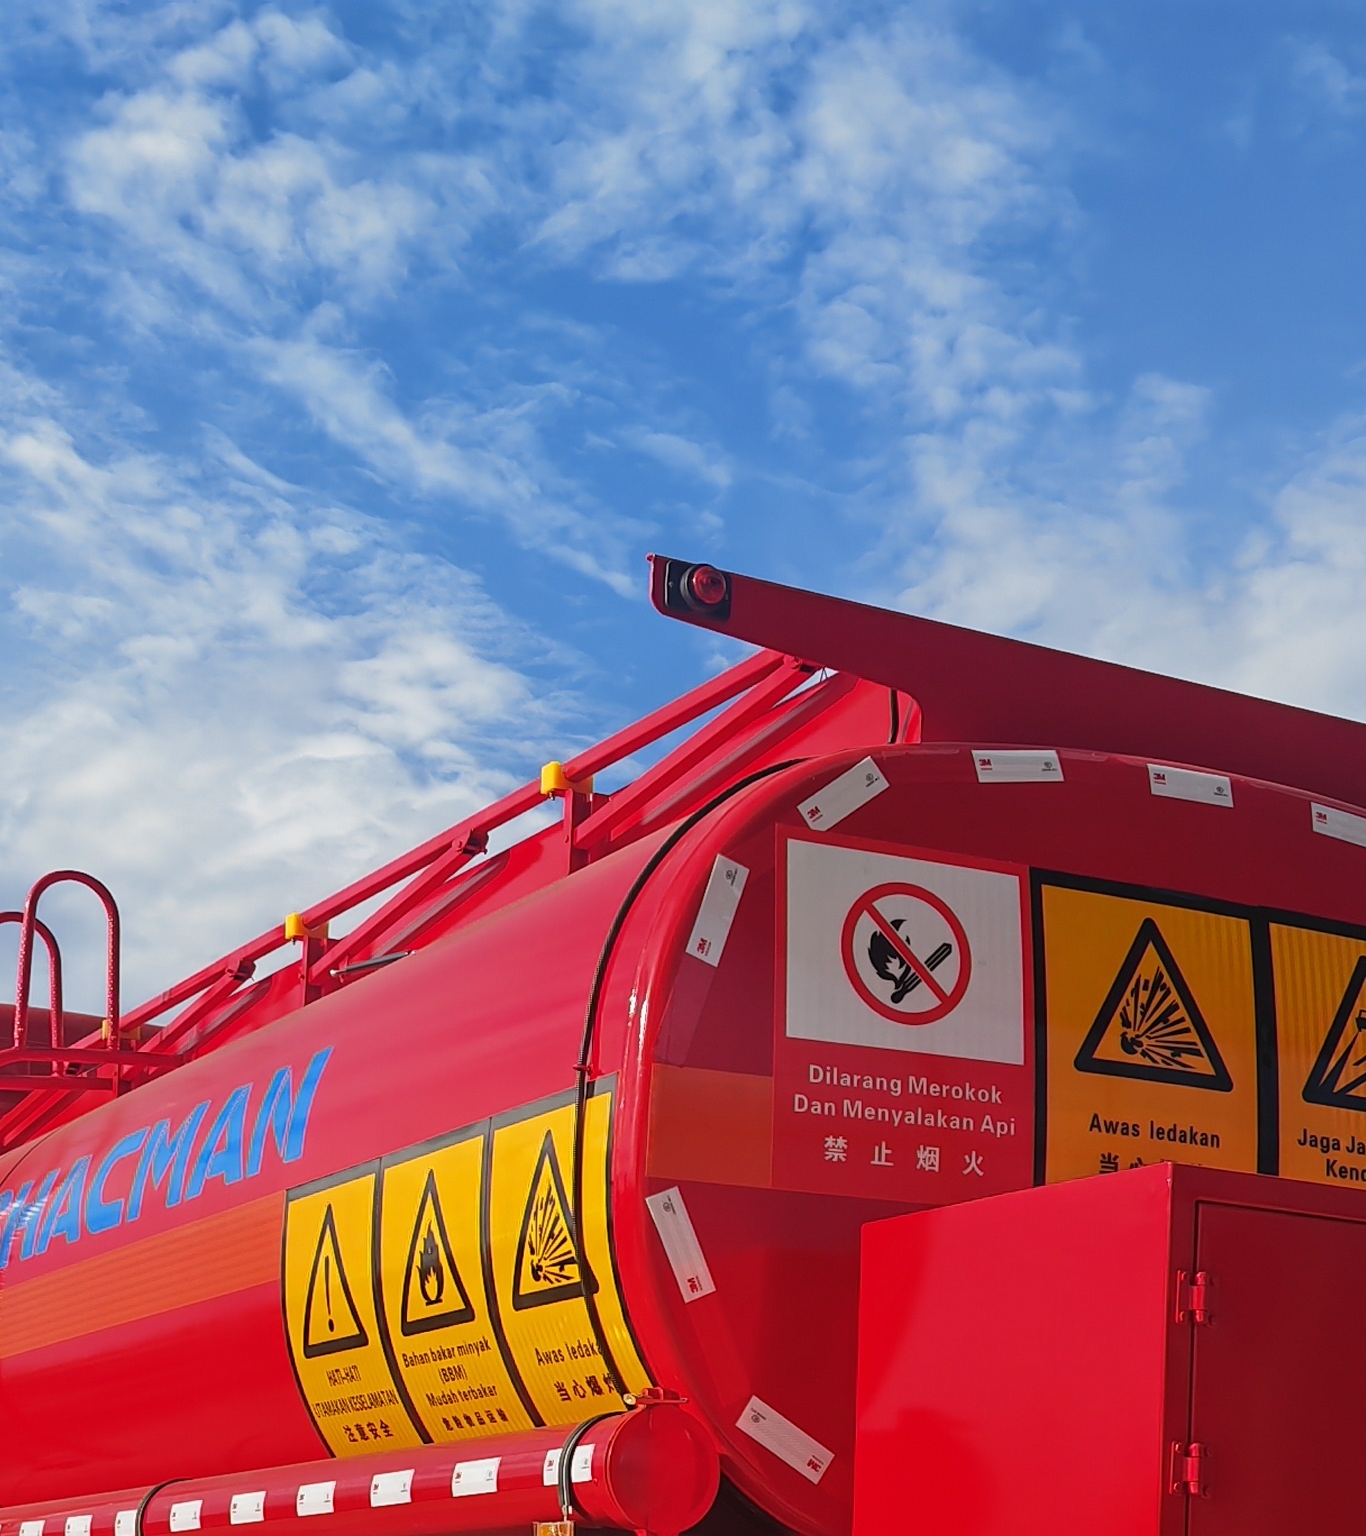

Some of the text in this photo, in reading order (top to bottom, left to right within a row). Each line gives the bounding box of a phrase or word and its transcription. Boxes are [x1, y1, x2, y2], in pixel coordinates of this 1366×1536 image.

[809, 1064, 1002, 1104] Dilarang Merokok
[793, 1094, 1016, 1138] Dan Menyalakan Api
[1089, 1113, 1221, 1148] Awas ledakan
[1297, 1128, 1341, 1153] Jaga
[824, 1135, 985, 1177] 禁止烟火
[402, 1336, 492, 1368] Bahan bakar minyak
[535, 1347, 565, 1367] Awas
[438, 1364, 468, 1385] (BBM)
[426, 1383, 498, 1407] Mudah terbakar
[343, 1419, 394, 1442] 注意安全
